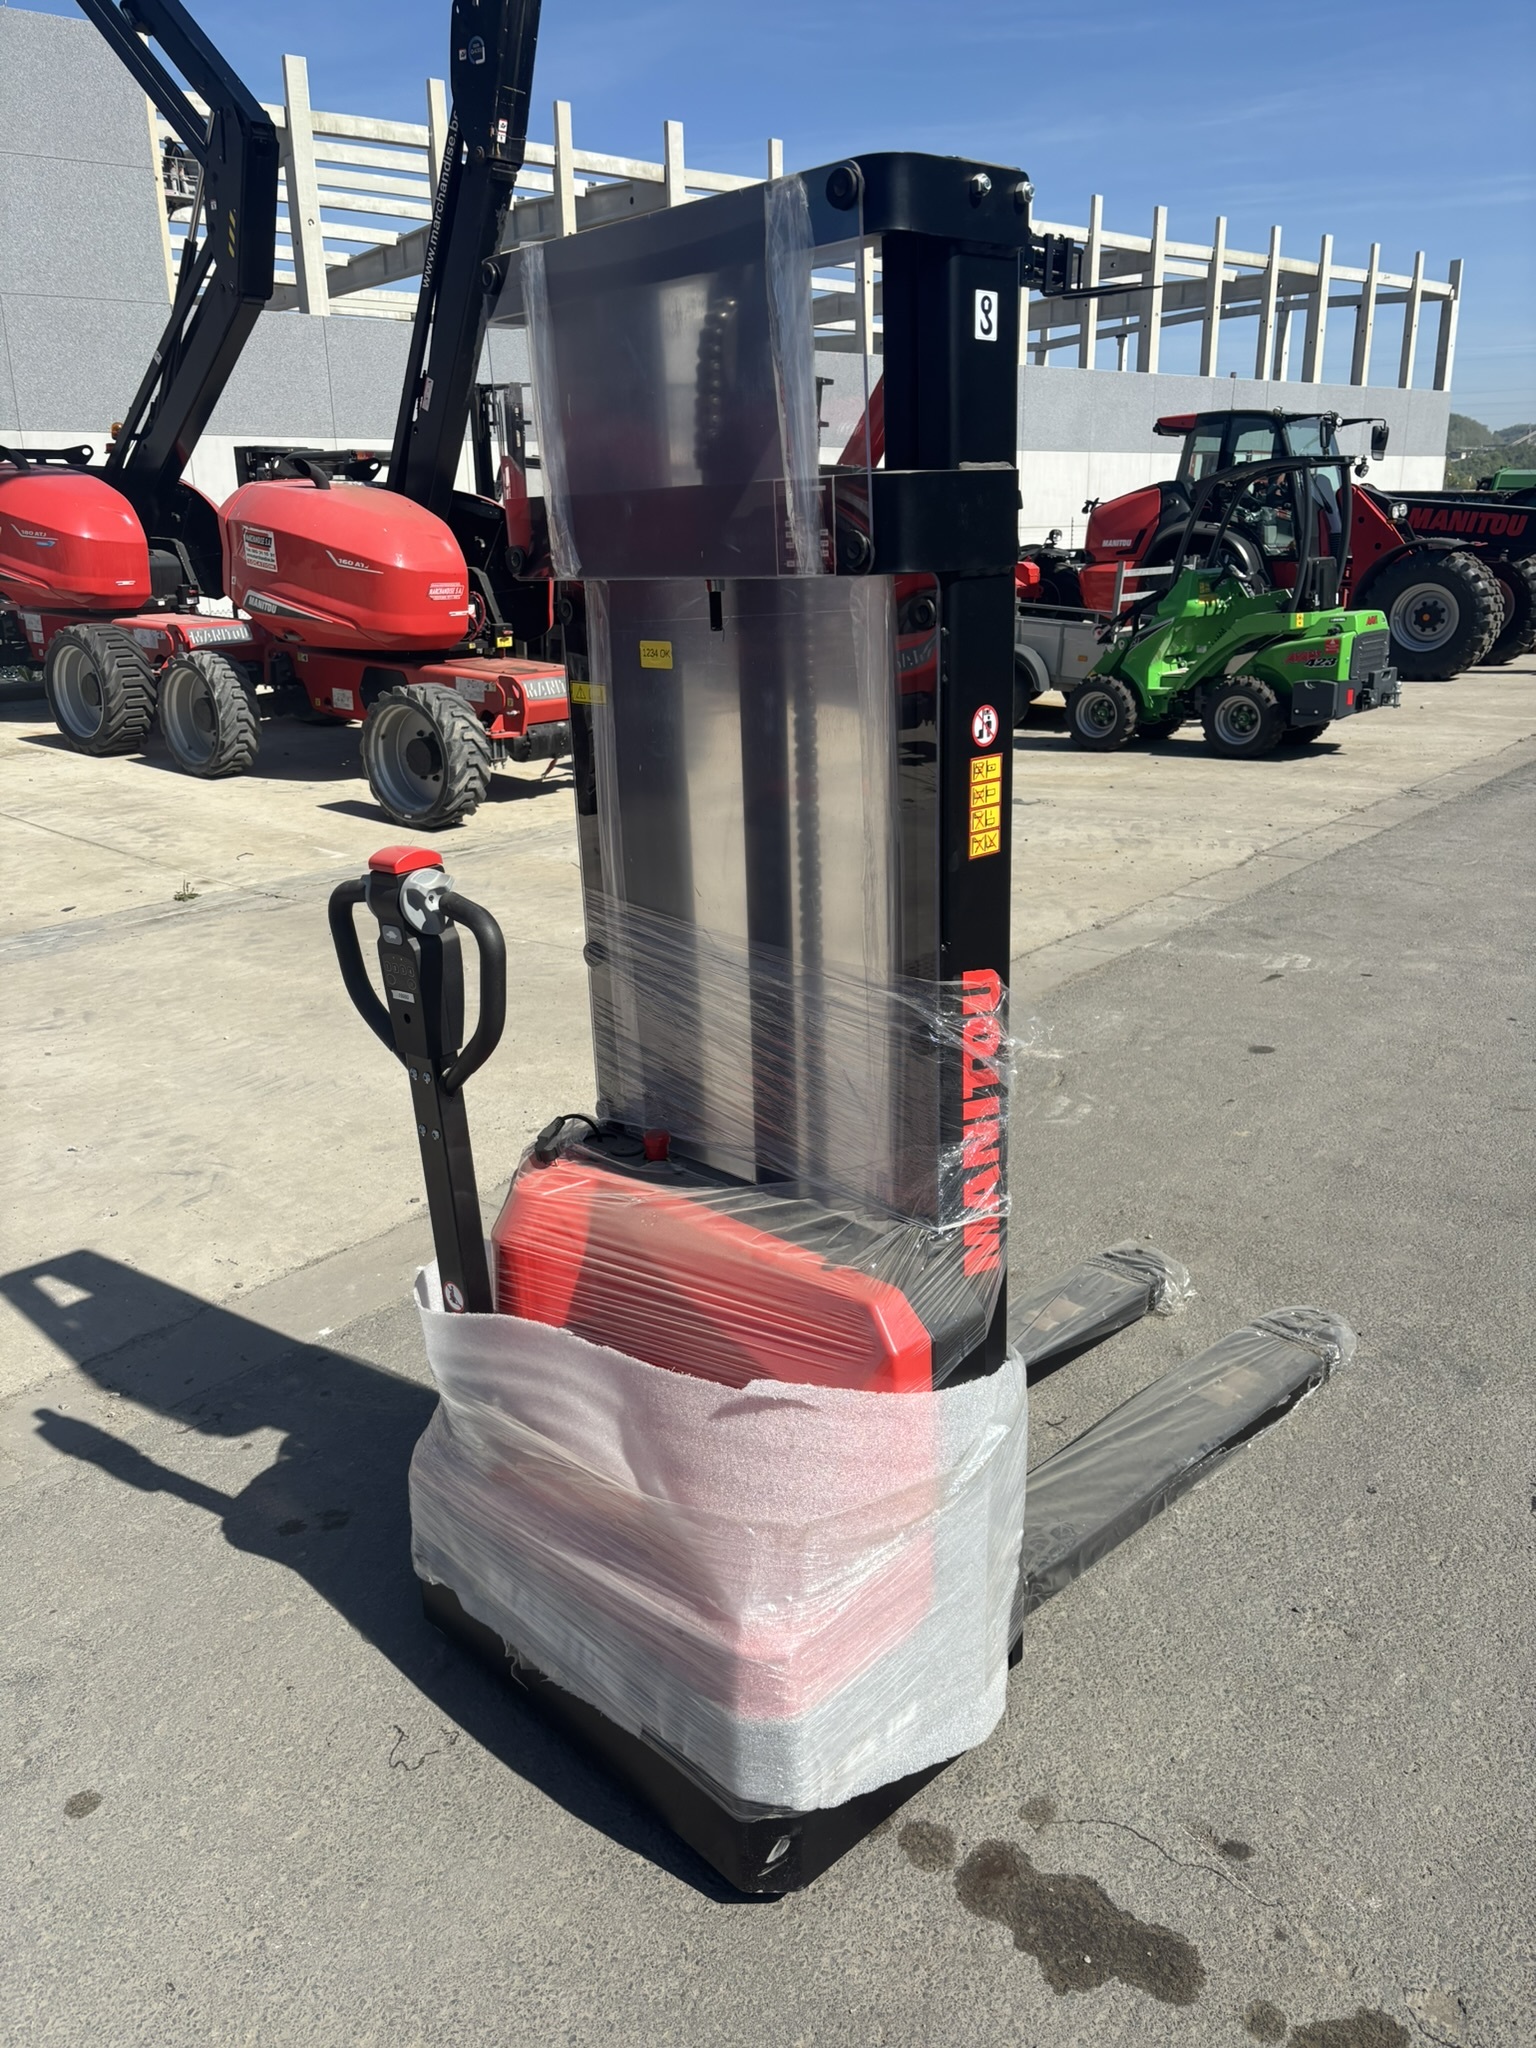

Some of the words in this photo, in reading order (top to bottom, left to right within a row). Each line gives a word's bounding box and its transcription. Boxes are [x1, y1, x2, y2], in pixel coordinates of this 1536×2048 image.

[1408, 507, 1528, 536] MANITOU
[1102, 539, 1132, 547] MANITOU
[248, 595, 278, 614] MANITOU
[189, 627, 249, 644] MANITOU
[660, 649, 671, 659] OK
[1305, 658, 1338, 668] 423
[962, 968, 1001, 1277] MANITOU
